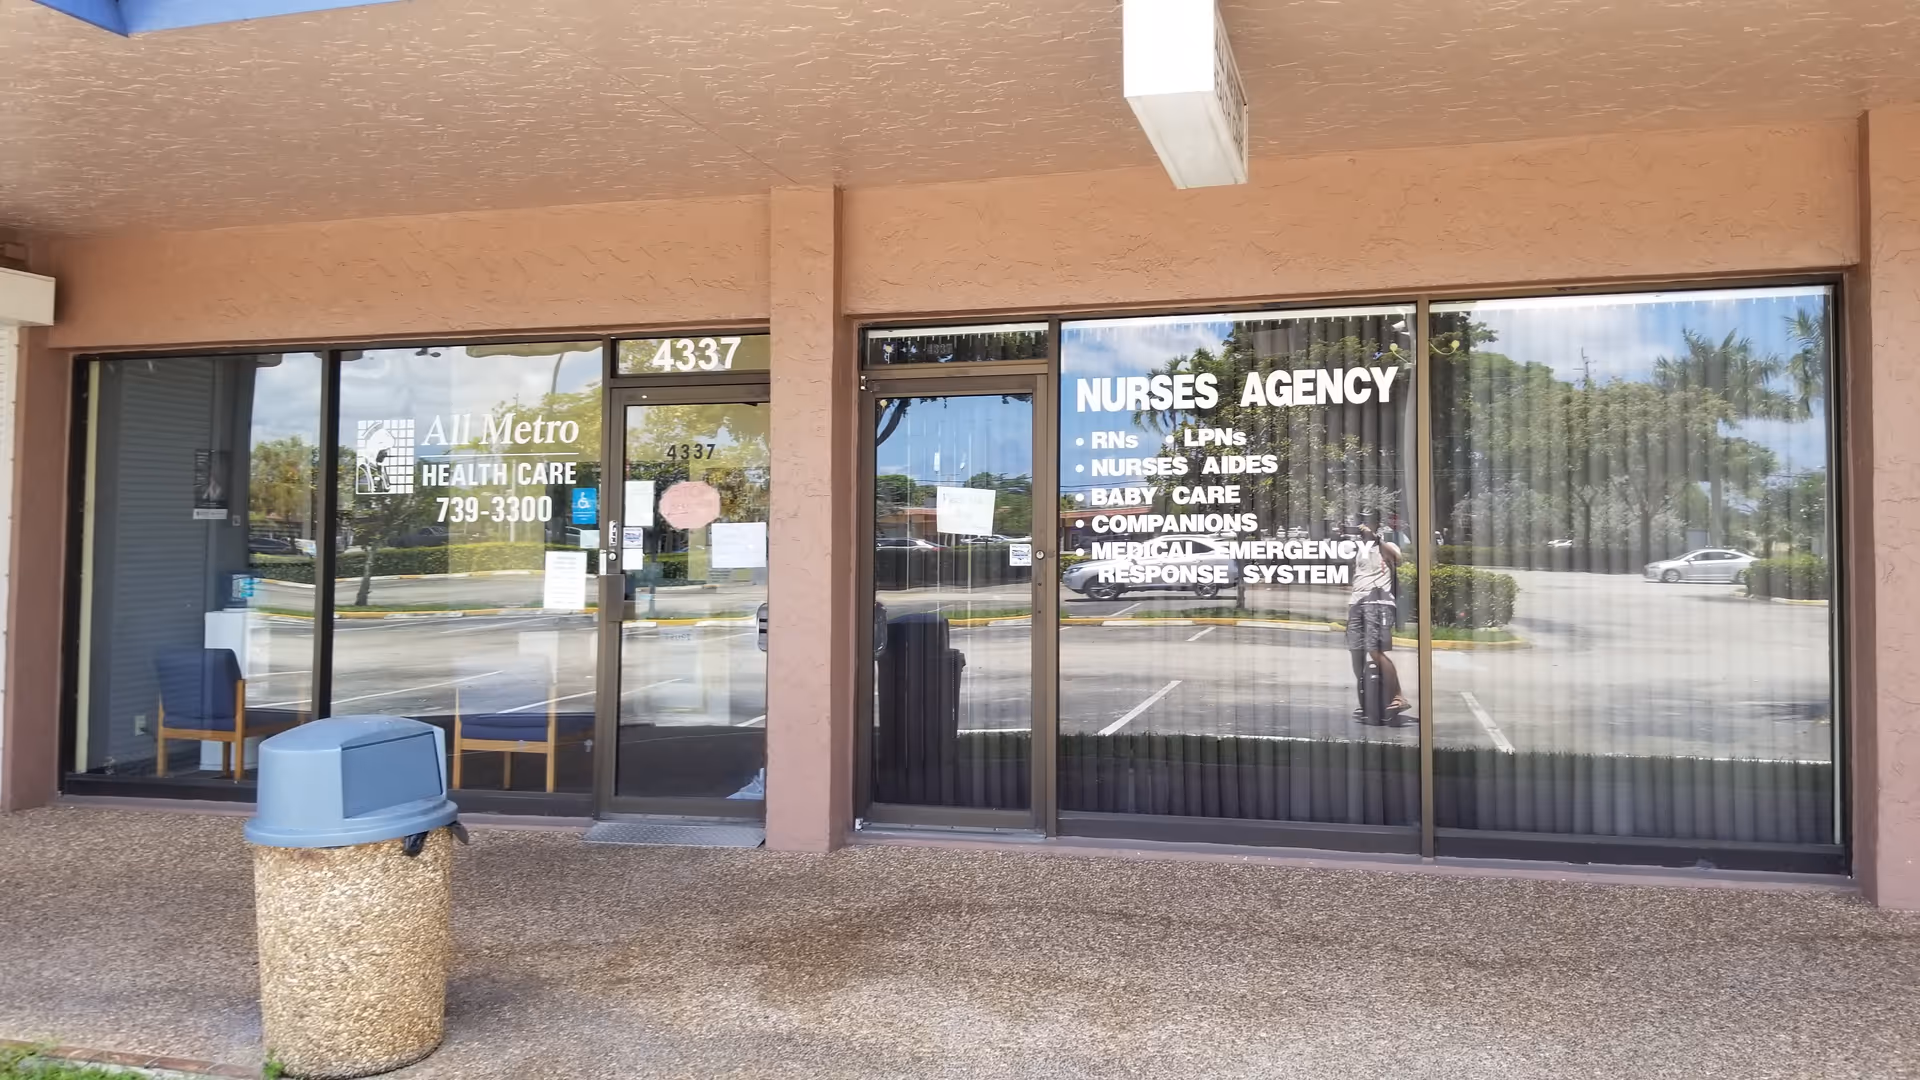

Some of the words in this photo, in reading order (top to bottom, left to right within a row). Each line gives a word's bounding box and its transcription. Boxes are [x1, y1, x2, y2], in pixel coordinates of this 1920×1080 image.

[651, 336, 741, 372] 4337
[1076, 372, 1219, 413] NURSES
[1240, 366, 1399, 407] AGENCY
[420, 412, 471, 446] All
[479, 412, 580, 446] Metro
[1091, 430, 1139, 449] RNs
[1184, 427, 1247, 447] LPNs
[666, 443, 716, 461] 4337
[422, 462, 508, 487] HEALTH
[517, 461, 577, 486] CARE
[1091, 457, 1189, 477] NURSES
[1202, 454, 1278, 475] AIDES
[1091, 486, 1158, 506] BABY
[1172, 484, 1241, 505] CARE
[436, 495, 552, 523] 739-3300
[1091, 513, 1258, 534] COMPANIONS
[1091, 541, 1196, 561] MEDICAL
[1214, 540, 1376, 560] EMERGENCY
[1098, 565, 1229, 585] RESPONSE
[1243, 564, 1349, 585] SYSTEM
